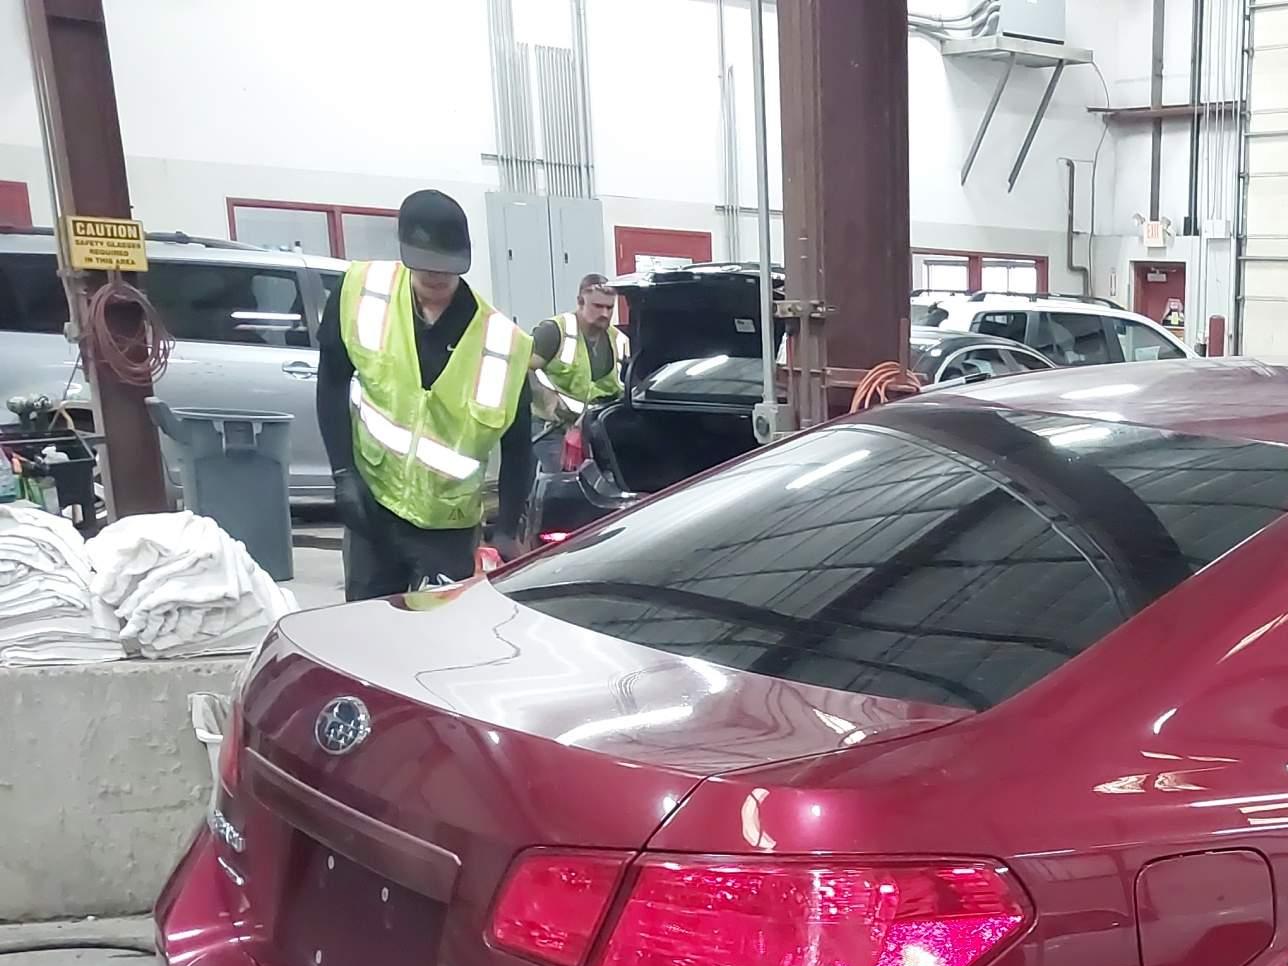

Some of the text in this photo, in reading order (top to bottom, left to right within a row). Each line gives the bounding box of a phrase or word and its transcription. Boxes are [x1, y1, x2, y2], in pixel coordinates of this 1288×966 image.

[75, 222, 138, 238] CAUTION
[1146, 223, 1160, 240] EXIT
[75, 239, 104, 247] SAFETY
